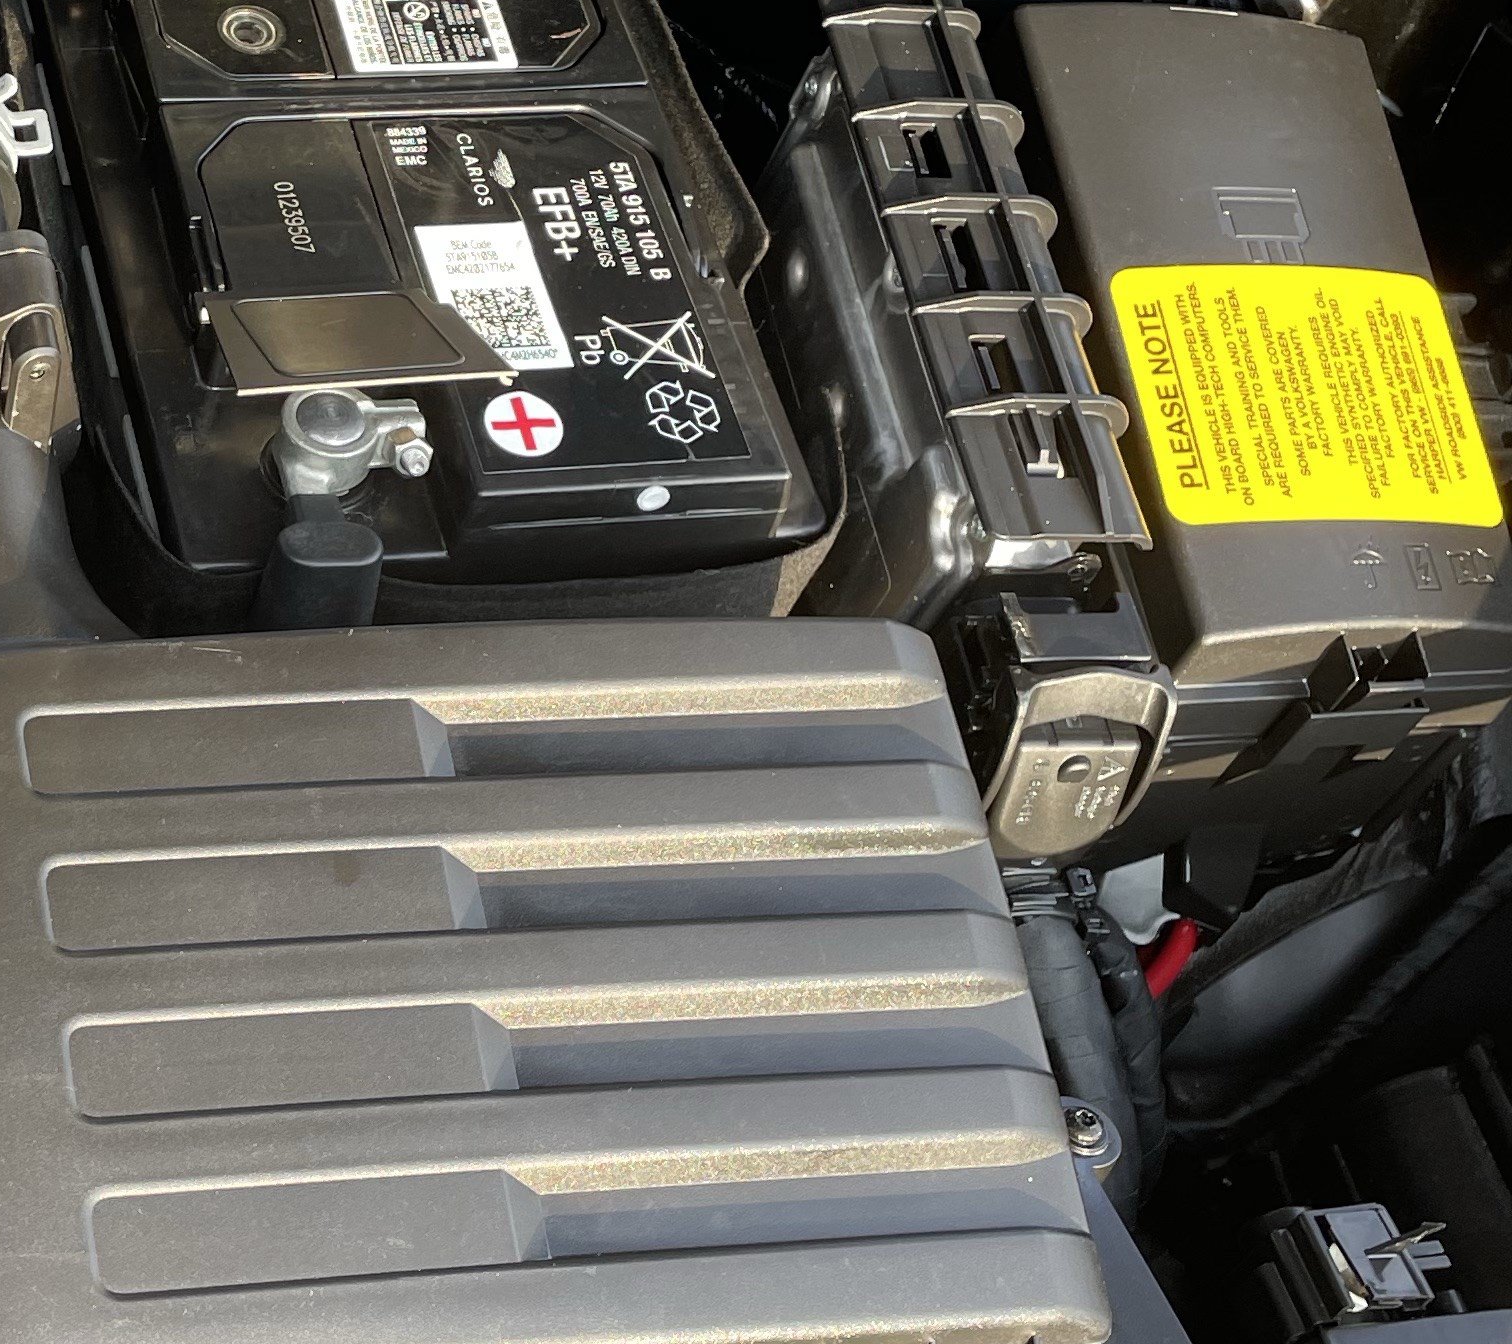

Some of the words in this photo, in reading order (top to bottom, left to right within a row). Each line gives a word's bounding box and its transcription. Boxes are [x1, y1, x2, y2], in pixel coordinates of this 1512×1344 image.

[386, 126, 426, 136] 884339
[395, 155, 427, 165] EMC
[456, 132, 494, 207] CLARIOS
[609, 161, 634, 197] 5TA
[274, 181, 316, 253] 01239507
[532, 187, 581, 262] EFB+
[589, 169, 610, 196] 12V
[621, 254, 642, 277] DIN
[621, 195, 651, 226] 915
[634, 231, 664, 260] 105
[650, 268, 672, 281] B
[1174, 293, 1191, 325] WITH
[1186, 283, 1215, 362] COMPUTERS.
[1213, 297, 1232, 338] TOOLS
[1225, 287, 1243, 324] THEM.
[1328, 298, 1344, 327] VOID
[1374, 297, 1389, 328] CALL
[574, 334, 604, 365] Pb
[1133, 303, 1173, 375] NOTE
[1225, 340, 1241, 367] AND
[1235, 327, 1260, 379] SERVICE
[1255, 305, 1280, 365] COVERED
[1307, 316, 1333, 379] REQUIRES
[1319, 312, 1341, 358] ENGINE
[1338, 330, 1353, 356] MAY
[1365, 310, 1394, 388] AUTHORIZED
[1410, 316, 1439, 390] ASSISTANCE
[1183, 327, 1209, 391] EQUIPPED
[1272, 368, 1287, 392] ARE
[1276, 331, 1308, 418] VOLKSWAGEN
[1200, 393, 1213, 406] IS
[1208, 365, 1235, 435] HIGH-TECH
[1234, 370, 1258, 429] TRAINING
[1251, 382, 1265, 400] TO
[1326, 382, 1349, 434] VEHICLE
[1333, 361, 1361, 430] SYNTHETIC
[1346, 360, 1369, 411] COMPLY
[1399, 388, 1415, 416] THIS
[1155, 384, 1202, 488] PLEASE
[1204, 408, 1227, 462] VEHICLE
[1257, 402, 1284, 468] REQUIRED
[1280, 396, 1300, 436] PARTS
[1301, 420, 1312, 430] A
[1310, 400, 1333, 457] FACTORY
[1361, 414, 1374, 431] TO
[1371, 402, 1395, 458] FACTORY
[1390, 393, 1413, 449] FACTORY
[1409, 418, 1422, 438] ON
[1417, 405, 1430, 425] VW
[1434, 394, 1461, 458] ROADSIDE
[1227, 437, 1249, 483] BOARD
[1253, 434, 1275, 486] SPECIAL
[1292, 439, 1311, 476] SOME
[1304, 432, 1318, 450] BY
[1343, 437, 1358, 463] THIS
[1367, 434, 1390, 486] FAILURE
[1423, 428, 1446, 480] HARPER
[1219, 464, 1236, 494] THIS
[1275, 471, 1292, 497] ARE
[1354, 433, 1381, 498] SPECIFIED
[1406, 452, 1421, 479] FOR
[1415, 441, 1439, 494] SERVICE
[1454, 459, 1467, 480] VW
[1240, 486, 1255, 506] ON
